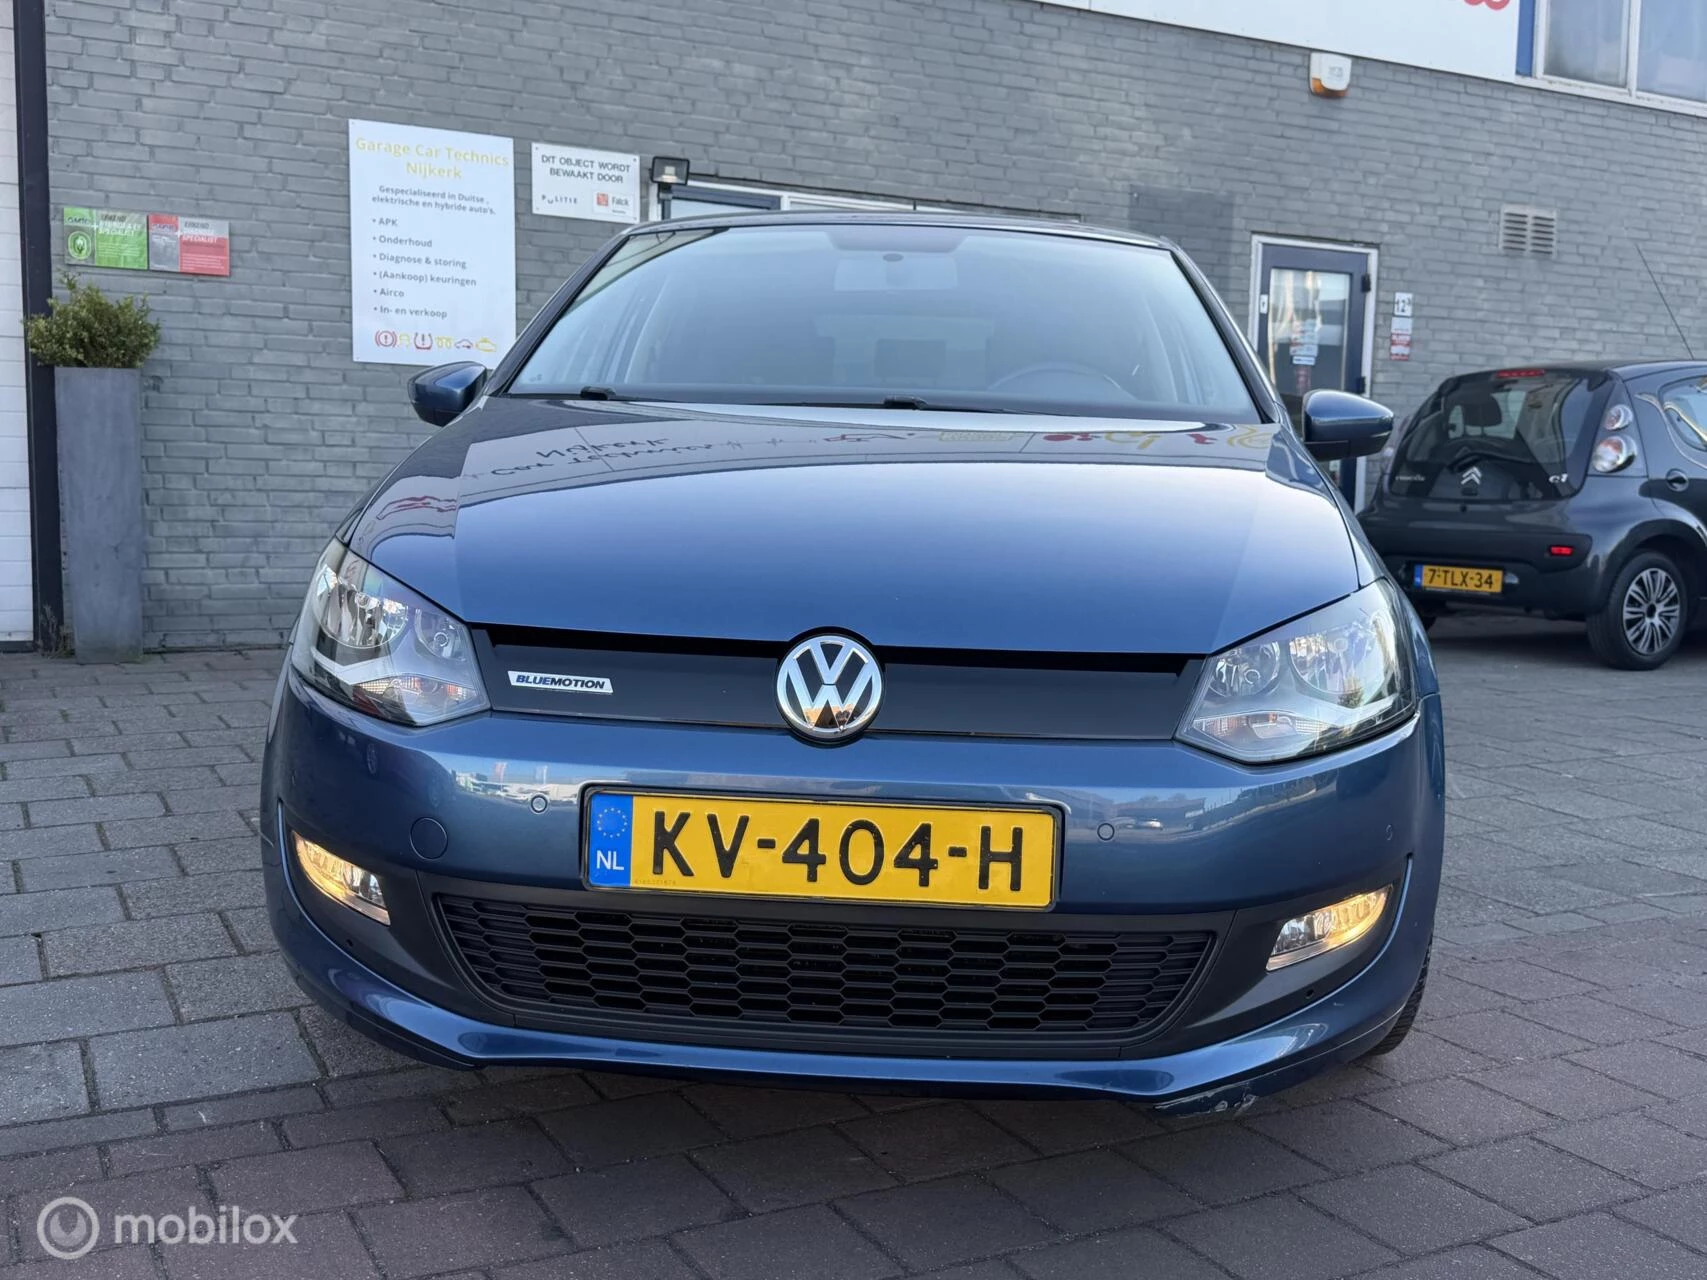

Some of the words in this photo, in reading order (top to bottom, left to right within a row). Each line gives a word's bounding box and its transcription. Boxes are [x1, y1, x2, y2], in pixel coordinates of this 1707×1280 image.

[355, 137, 410, 157] Garage
[415, 144, 440, 159] Car
[445, 147, 509, 166] Technics
[406, 162, 462, 179] Nijkerk
[541, 155, 556, 164] DIT
[559, 157, 595, 168] OBJECT
[598, 162, 631, 173] WORDT
[549, 168, 595, 179] BEWAAKT
[597, 173, 623, 183] DOOR
[379, 185, 446, 199] Gespecialiseerd
[447, 191, 456, 200] in
[458, 193, 485, 202] Duitse
[372, 195, 421, 207] elektrische
[422, 200, 433, 208] en
[434, 201, 467, 213] hybride
[378, 217, 398, 227] APK
[378, 235, 433, 247] Onderhoud
[379, 253, 422, 264] Diagnose
[424, 257, 432, 265] &
[434, 258, 467, 270] storing
[379, 271, 429, 284] (Aankoop)
[430, 275, 477, 288] keuringen
[379, 288, 405, 298] Airco
[380, 305, 393, 314] In-
[395, 308, 406, 316] en
[409, 308, 448, 320] verkoop
[1428, 568, 1494, 589] 7-TLX-34
[515, 673, 606, 690] BLUEMOTION
[651, 809, 1024, 892] KV-404-H
[596, 850, 625, 871] NL
